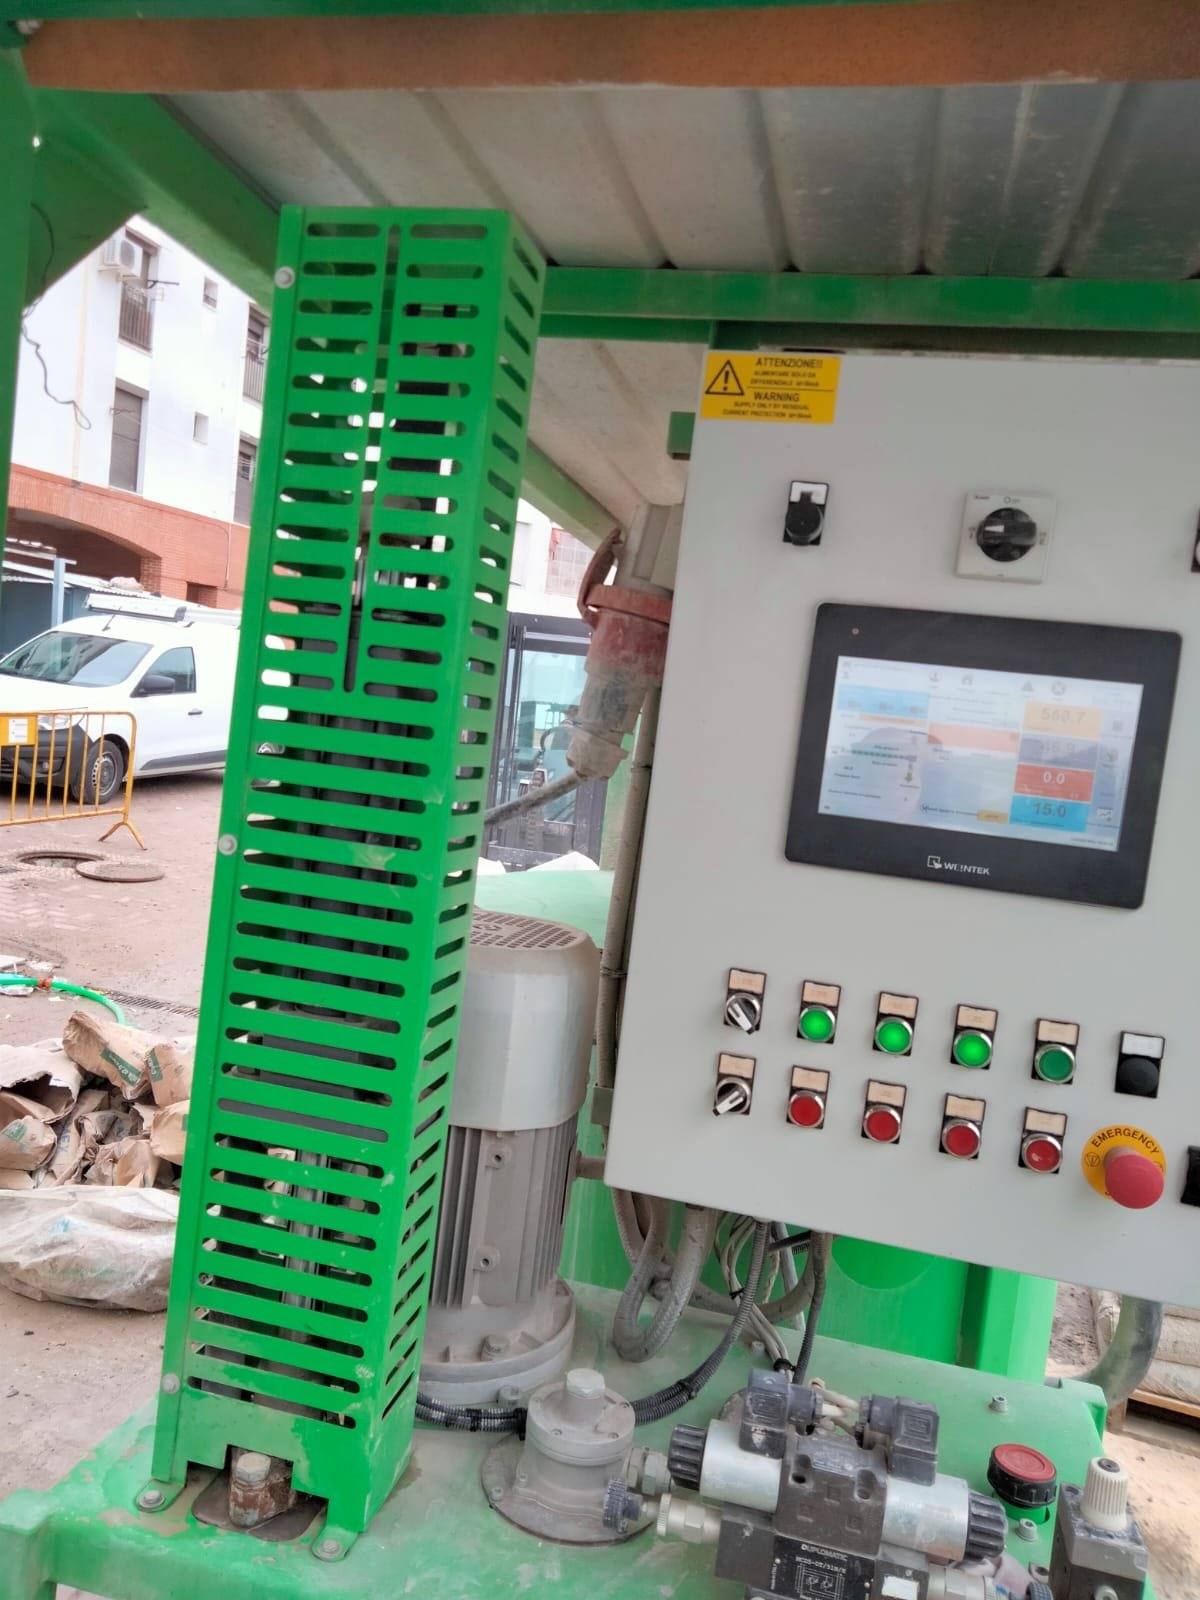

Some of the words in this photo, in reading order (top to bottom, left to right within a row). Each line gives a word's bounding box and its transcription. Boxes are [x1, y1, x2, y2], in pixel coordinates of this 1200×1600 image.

[754, 392, 800, 402] WARNING
[1042, 771, 1065, 784] 0.0
[1033, 802, 1066, 817] 15.0
[1092, 1128, 1160, 1154] EMERGENCY
